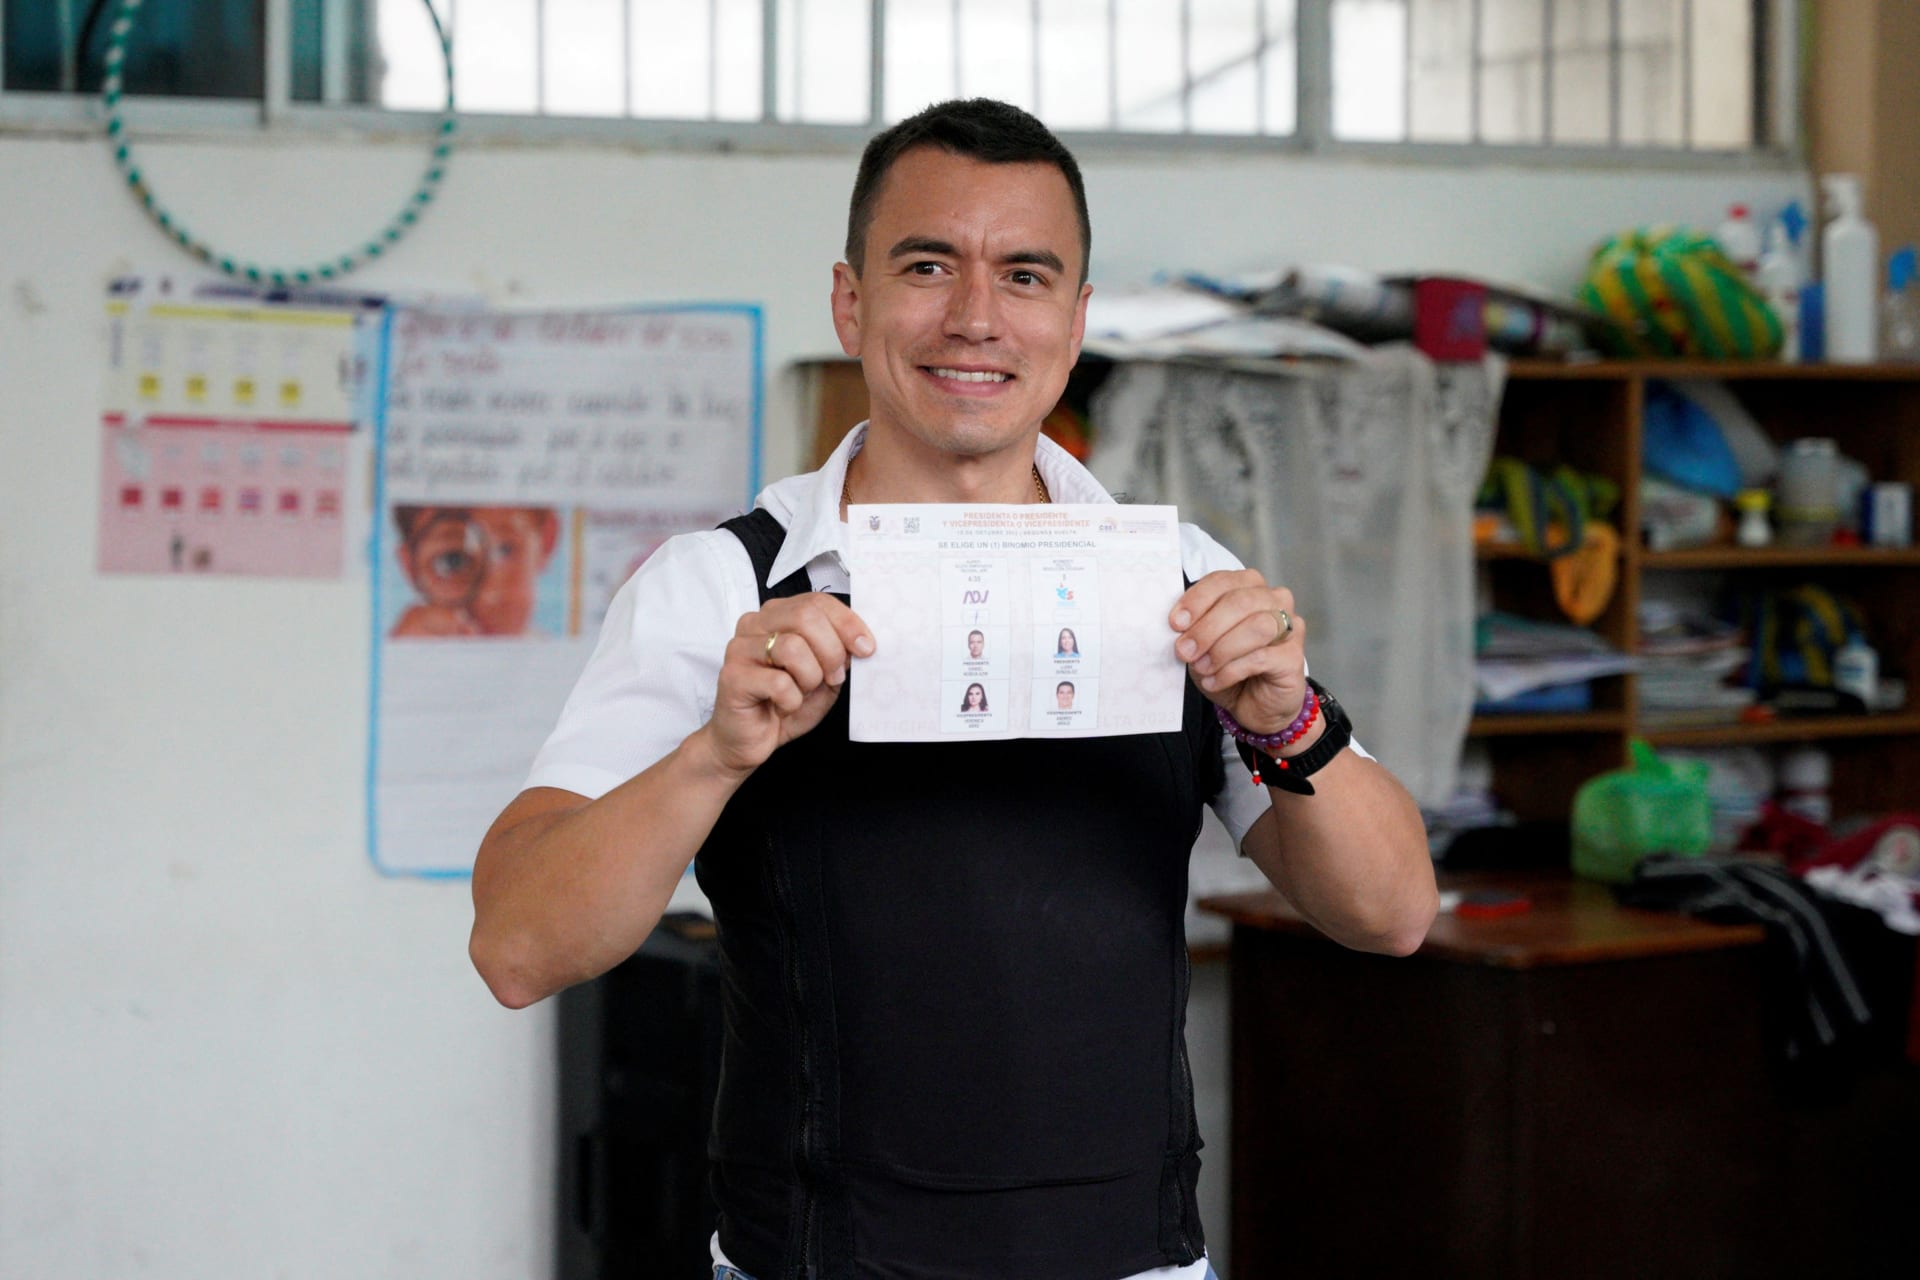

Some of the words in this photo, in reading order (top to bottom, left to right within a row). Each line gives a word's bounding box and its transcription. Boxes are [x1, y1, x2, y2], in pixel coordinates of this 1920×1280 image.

[963, 512, 1010, 520] PRESIDENTA
[1012, 512, 1018, 520] O
[1019, 512, 1069, 520] PRESIDENTE
[942, 520, 948, 528] Y
[950, 520, 1016, 528] VICEPRESIDENTA
[1024, 520, 1090, 528] VICEPRESIDENTE
[937, 541, 949, 549] SE
[950, 541, 974, 549] ELIGE
[977, 541, 988, 549] UN
[990, 541, 1000, 550] (1)
[1002, 541, 1036, 549] BINOMIO
[1038, 540, 1097, 549] PRESIDENCIAL
